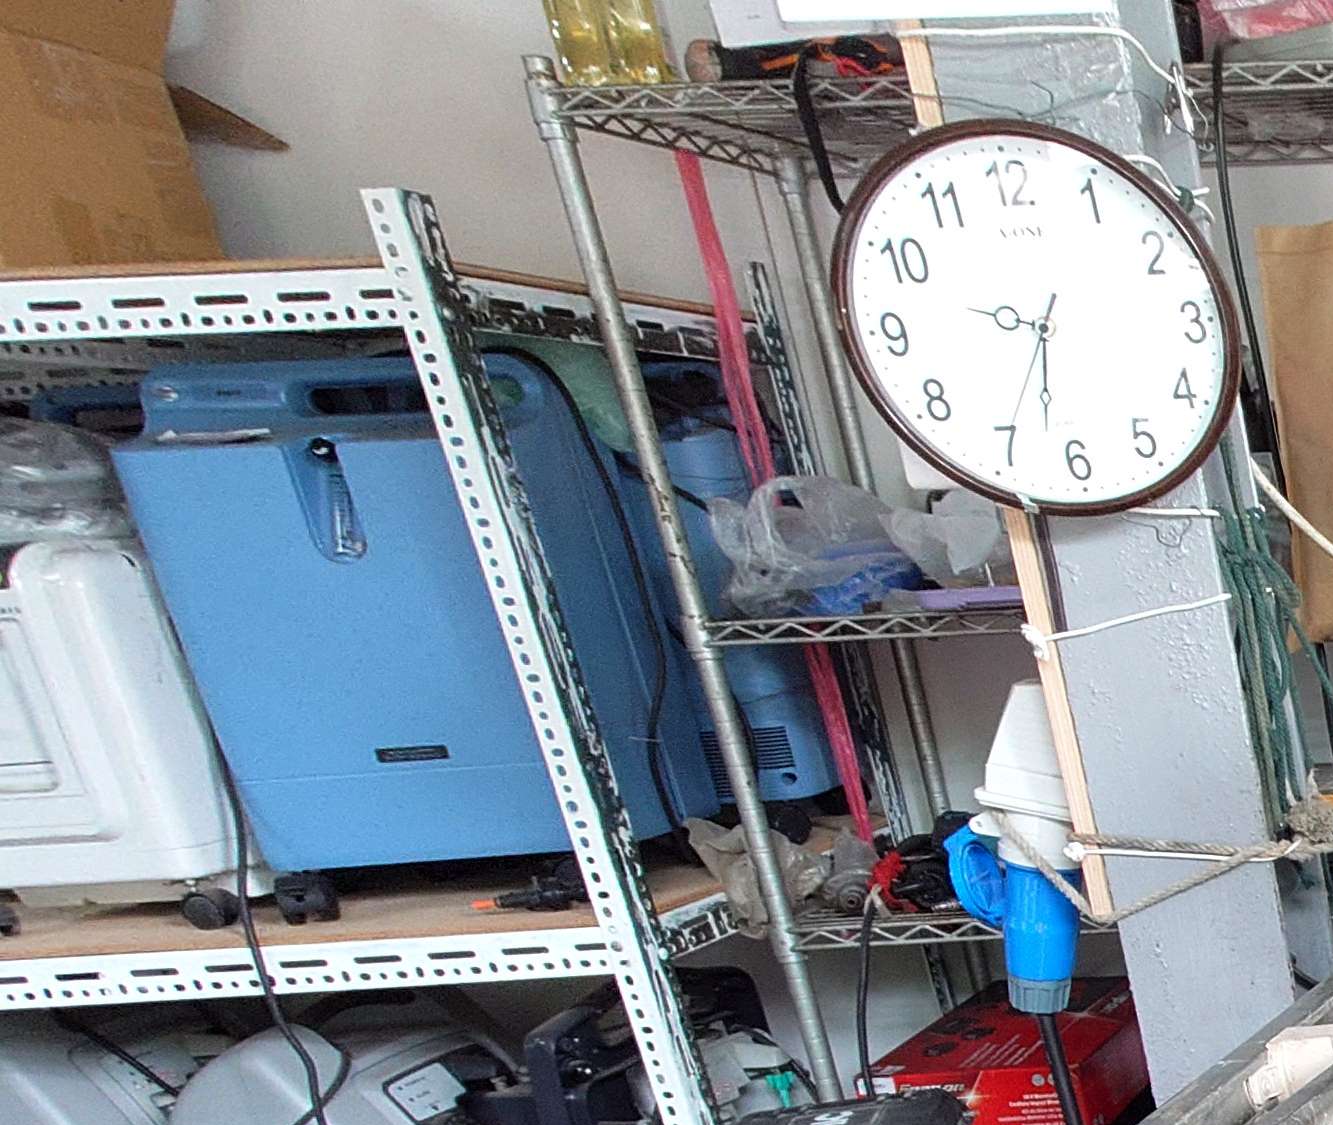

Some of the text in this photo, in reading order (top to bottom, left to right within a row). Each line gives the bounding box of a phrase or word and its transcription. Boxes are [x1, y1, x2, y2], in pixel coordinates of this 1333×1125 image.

[920, 182, 965, 228] 11
[985, 160, 1035, 206] 12
[1080, 178, 1101, 224] 1
[880, 237, 929, 284] 10
[1141, 231, 1166, 275] 2
[880, 312, 909, 357] 9
[1180, 301, 1207, 344] 3
[923, 378, 951, 422] 8
[1173, 367, 1197, 409] 4
[993, 425, 1017, 467] 7
[1131, 417, 1157, 459] 5
[1065, 440, 1092, 481] 6
